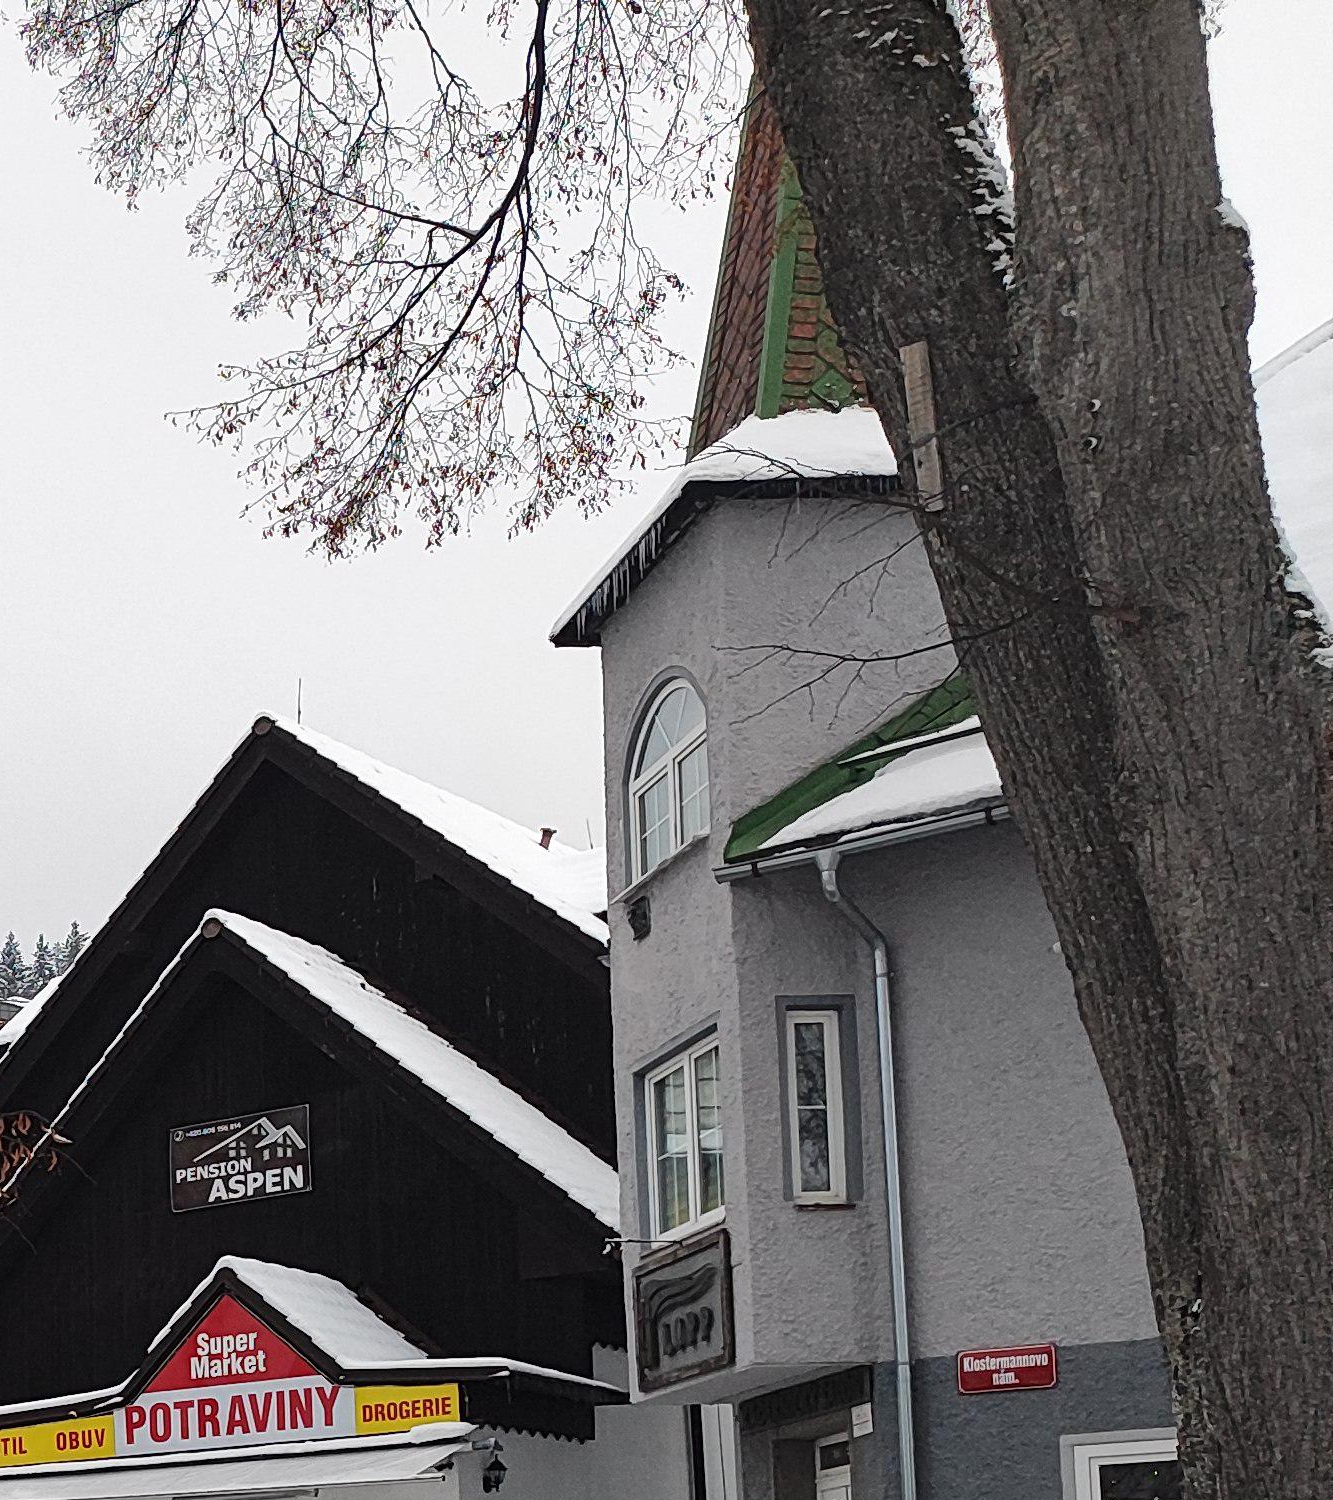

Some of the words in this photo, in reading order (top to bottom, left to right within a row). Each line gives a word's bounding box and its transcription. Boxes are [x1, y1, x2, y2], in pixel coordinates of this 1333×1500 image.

[176, 1157, 252, 1183] PENSION
[208, 1165, 304, 1202] ASPEN
[197, 1332, 257, 1359] Super
[190, 1350, 266, 1380] Market
[963, 1353, 1049, 1373] Klostermannovo
[125, 1386, 340, 1444] POTRAVINY
[362, 1396, 452, 1423] DROGERIE
[56, 1428, 106, 1451] OBUV
